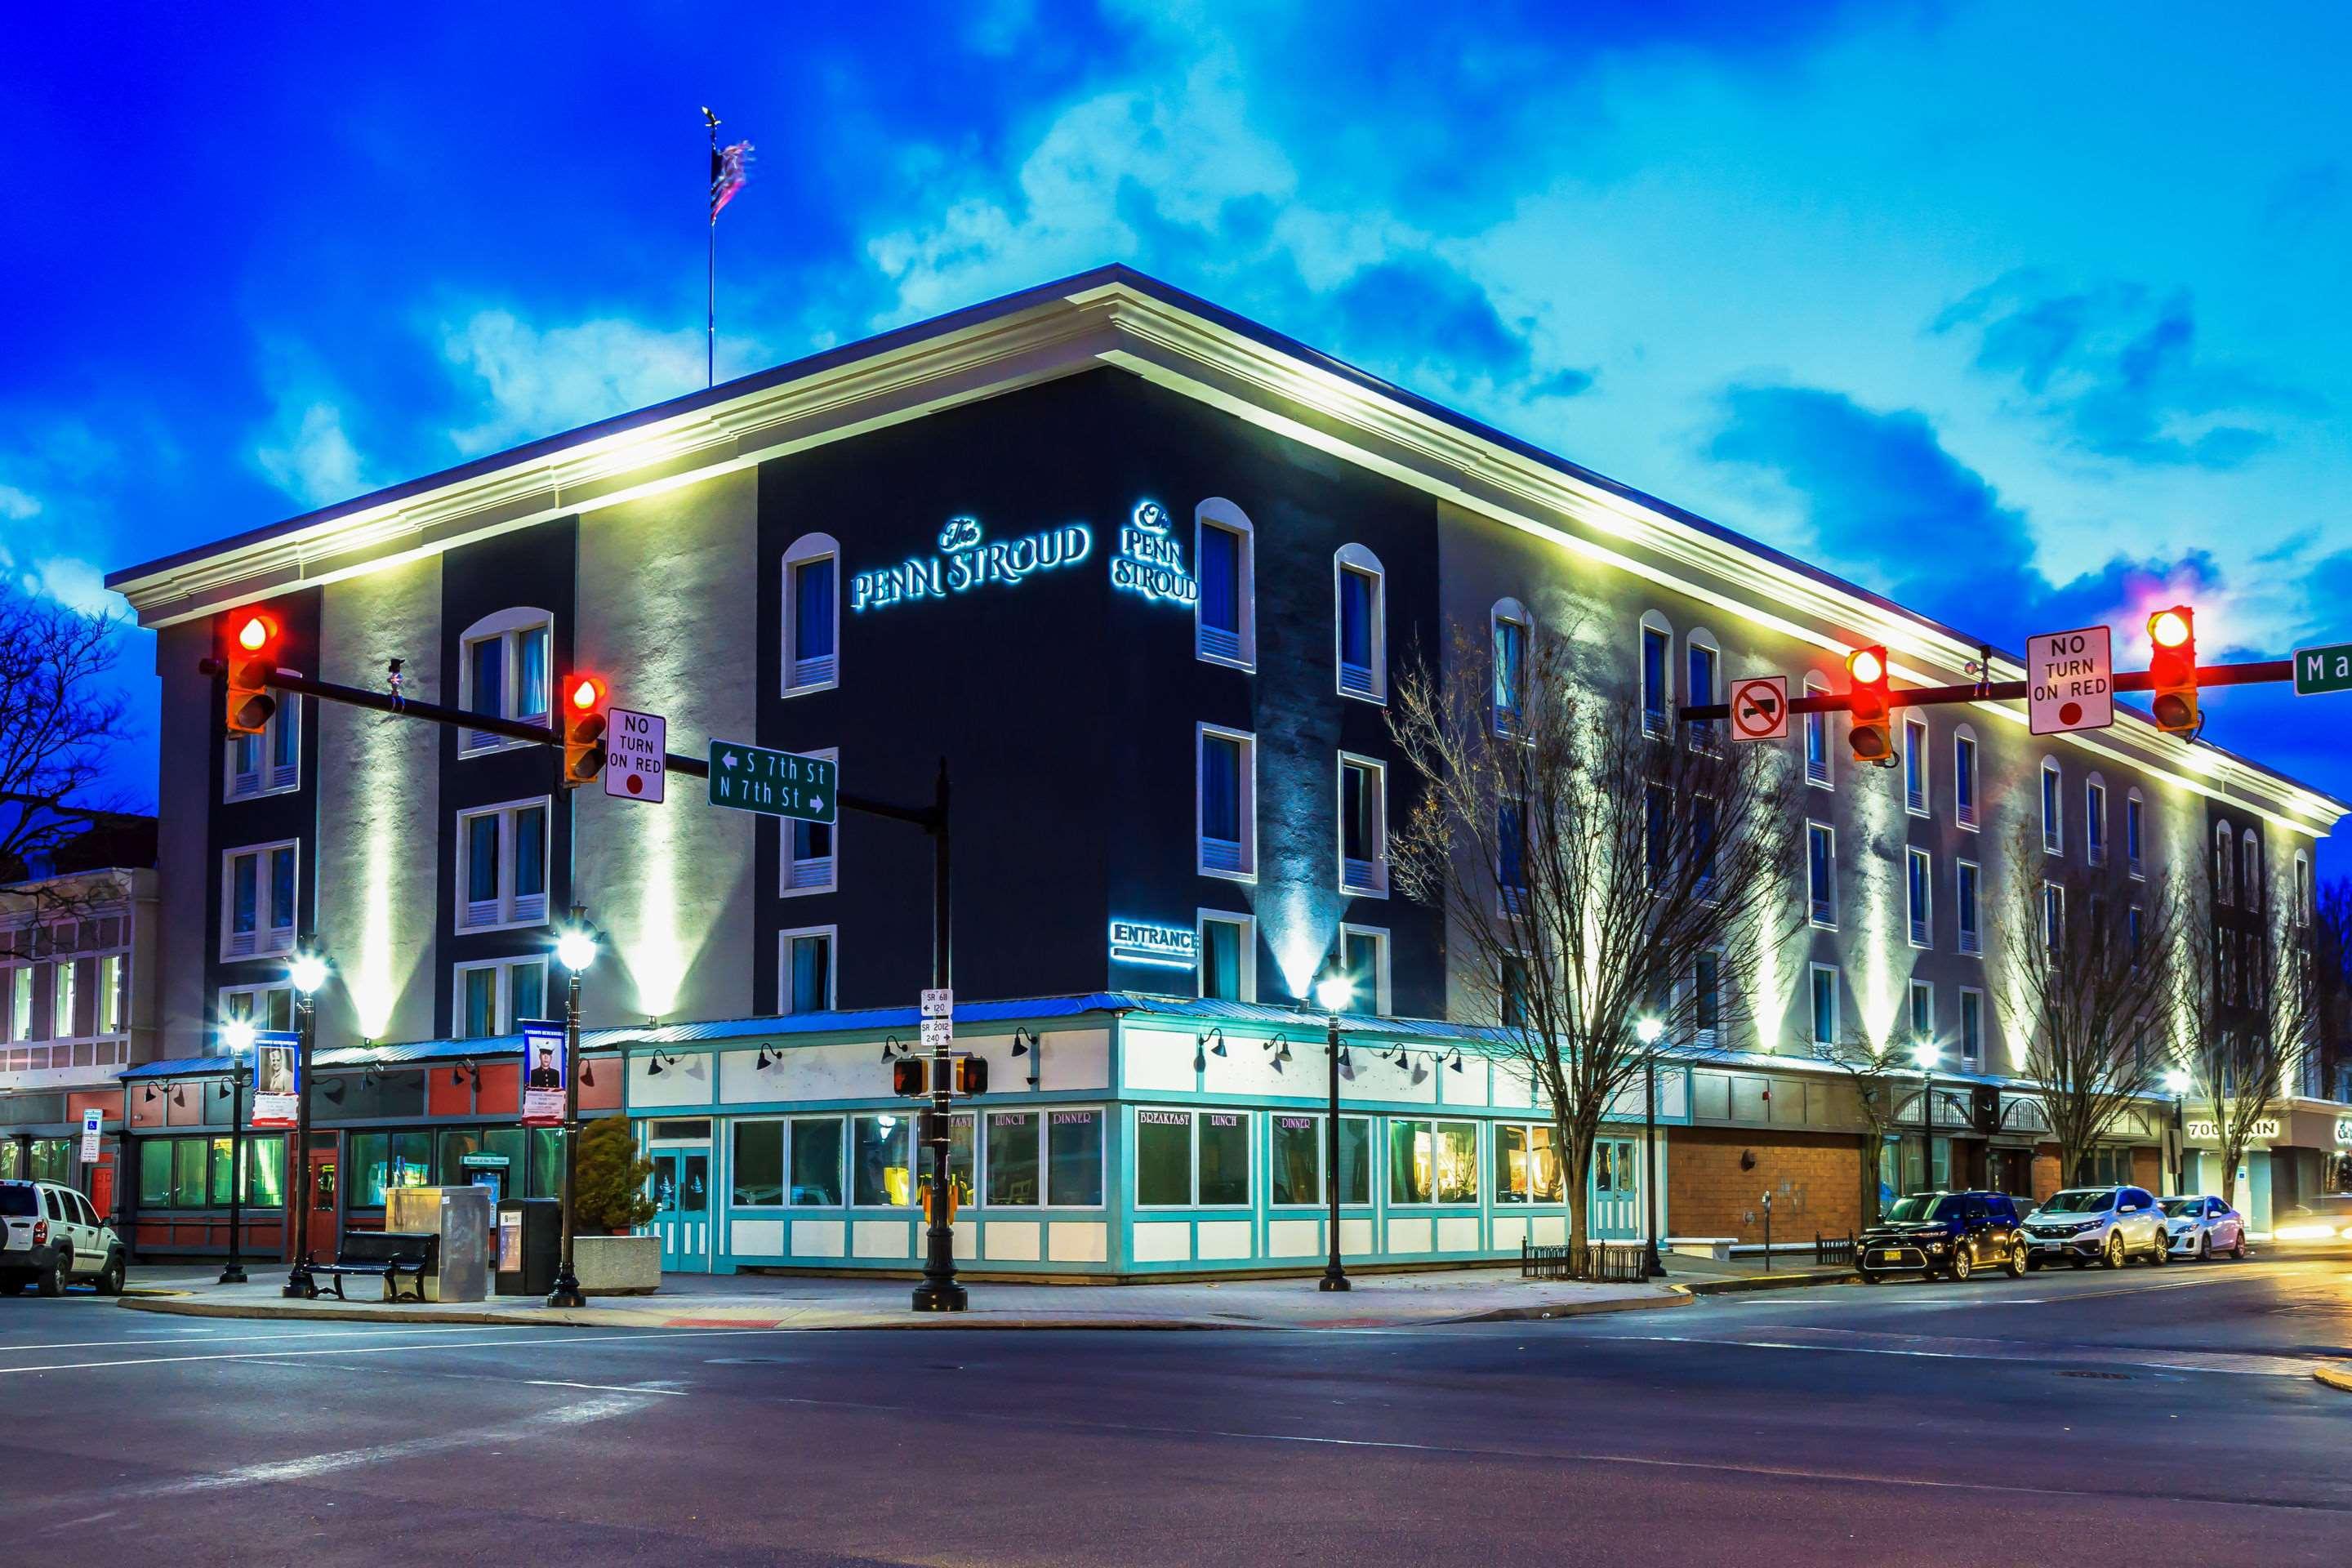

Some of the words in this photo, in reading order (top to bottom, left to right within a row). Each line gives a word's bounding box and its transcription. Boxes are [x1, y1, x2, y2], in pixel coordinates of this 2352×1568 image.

[940, 518, 979, 550] The
[1123, 528, 1185, 573] PENN
[850, 559, 946, 607] PENN
[947, 527, 1089, 588] STROUD
[1114, 559, 1198, 601] STROUD
[2051, 635, 2085, 657] NO
[2045, 657, 2093, 679] TURN
[2307, 654, 2349, 681] Ma
[2034, 684, 2058, 701] ON
[2070, 678, 2106, 697] RED
[625, 715, 648, 733] NO
[620, 736, 653, 754] TURN
[610, 752, 627, 768] ON
[636, 759, 661, 773] RED
[746, 752, 755, 773] S
[768, 756, 797, 780] 7th
[807, 763, 824, 785] St
[720, 777, 729, 797] N
[742, 780, 772, 804] 7th
[782, 787, 799, 808] St
[1114, 924, 1200, 948] ENTRANCE
[927, 993, 936, 1001] SR
[939, 993, 947, 1001] 611
[934, 1004, 945, 1012] 120
[922, 1023, 930, 1031] SR
[933, 1022, 948, 1031] 2012
[927, 1034, 939, 1042] 240
[995, 1115, 1025, 1125] LUNCH
[1054, 1112, 1091, 1125] DINNER
[1140, 1112, 1189, 1125] BREAKFAST
[1211, 1115, 1236, 1126] LUNCH
[1282, 1117, 1310, 1129] DINNER
